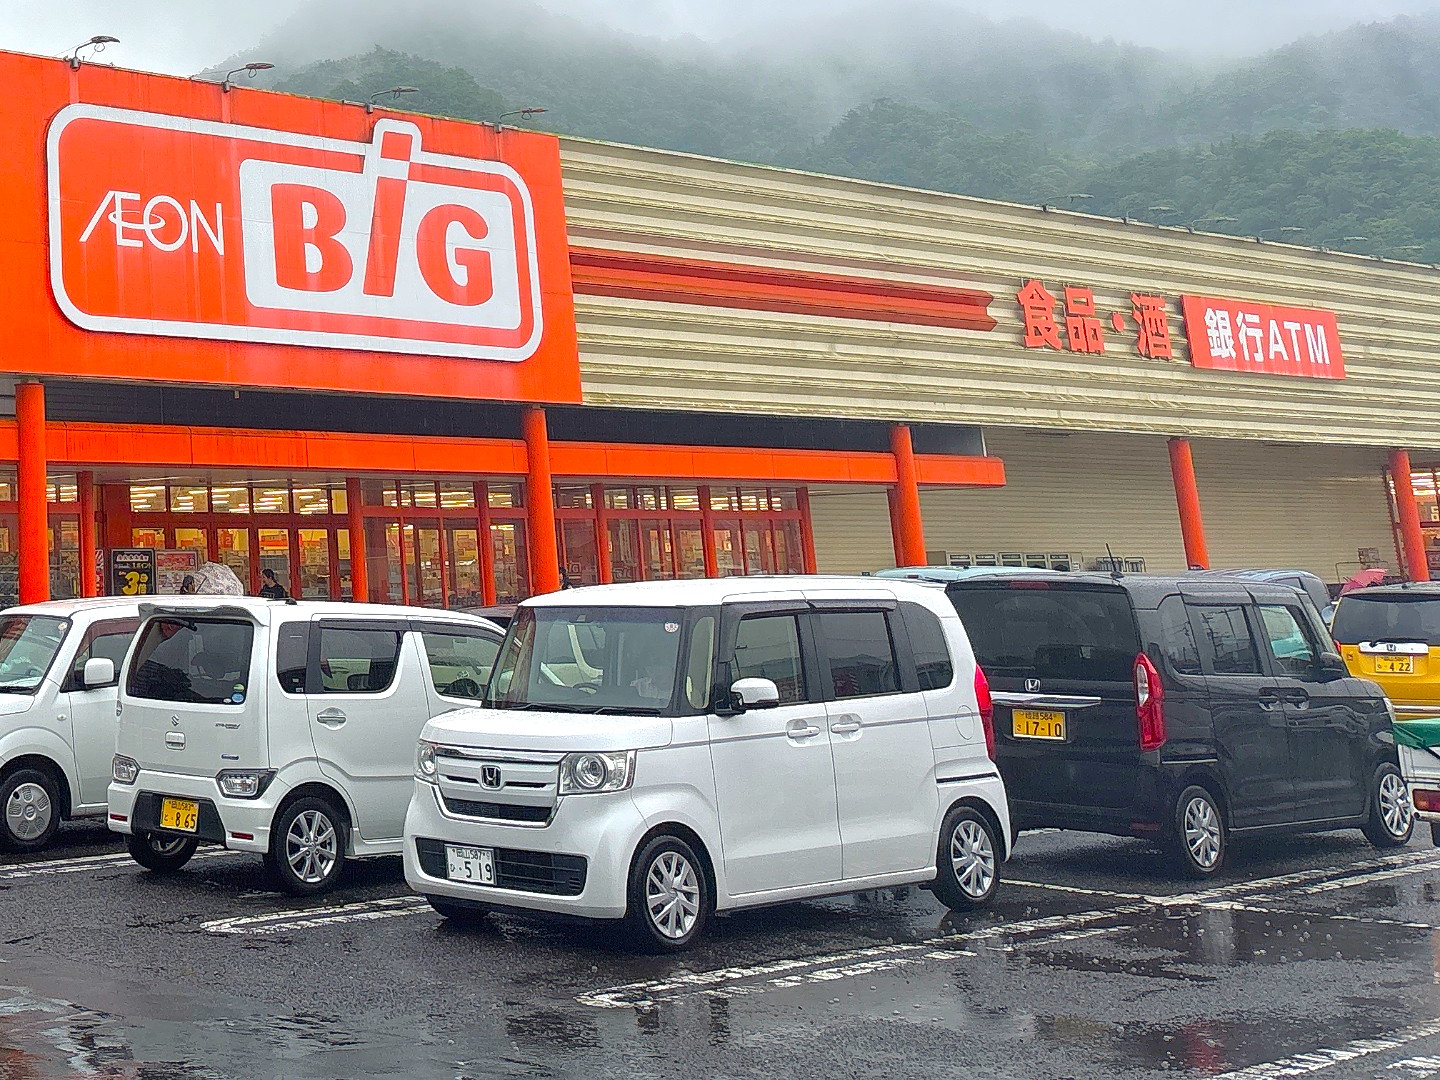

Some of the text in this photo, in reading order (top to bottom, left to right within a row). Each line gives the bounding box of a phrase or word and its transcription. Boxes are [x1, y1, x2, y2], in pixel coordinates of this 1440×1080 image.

[1016, 279, 1172, 360] 食品・酒
[1204, 307, 1330, 365] 銀行ATM
[1026, 721, 1063, 737] 17-10
